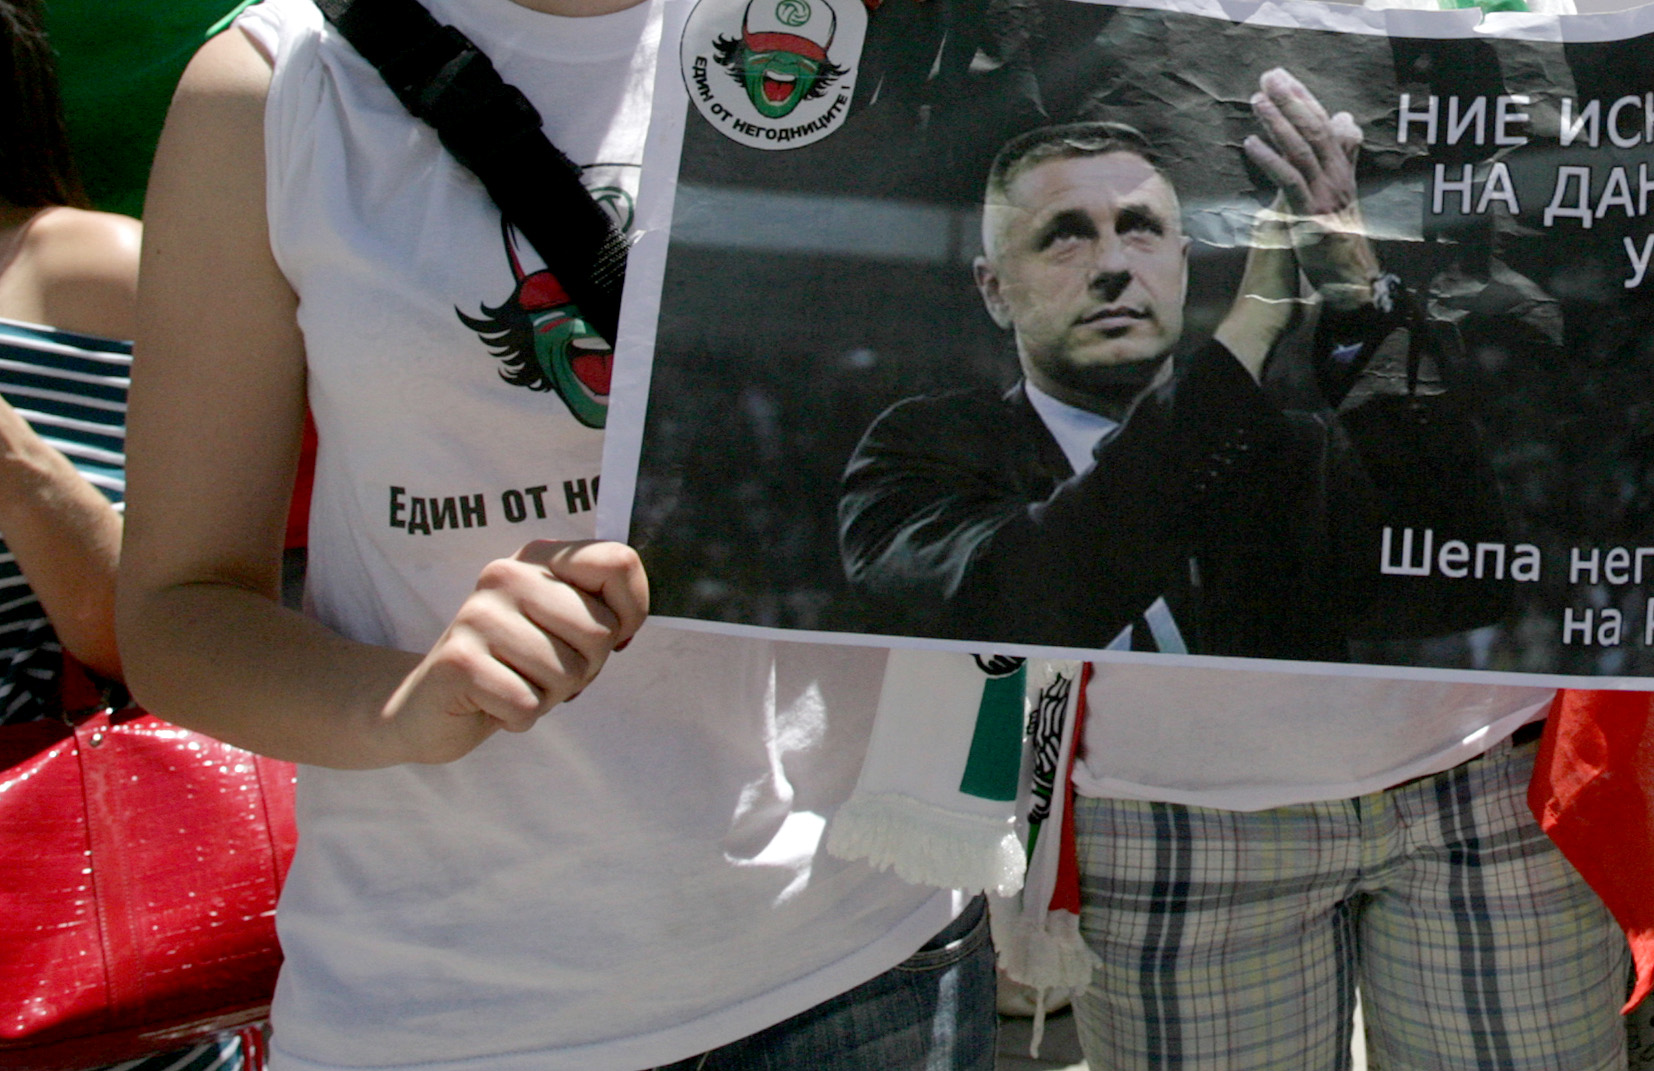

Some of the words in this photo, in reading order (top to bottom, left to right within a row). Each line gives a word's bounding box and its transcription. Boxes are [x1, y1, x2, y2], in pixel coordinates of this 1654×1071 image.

[692, 55, 714, 103] ЕДИН
[710, 103, 733, 122] ОТ
[1397, 93, 1531, 148] НИЕ
[1432, 163, 1520, 215] НА
[1379, 526, 1542, 584] Шепа
[1562, 608, 1623, 647] на
